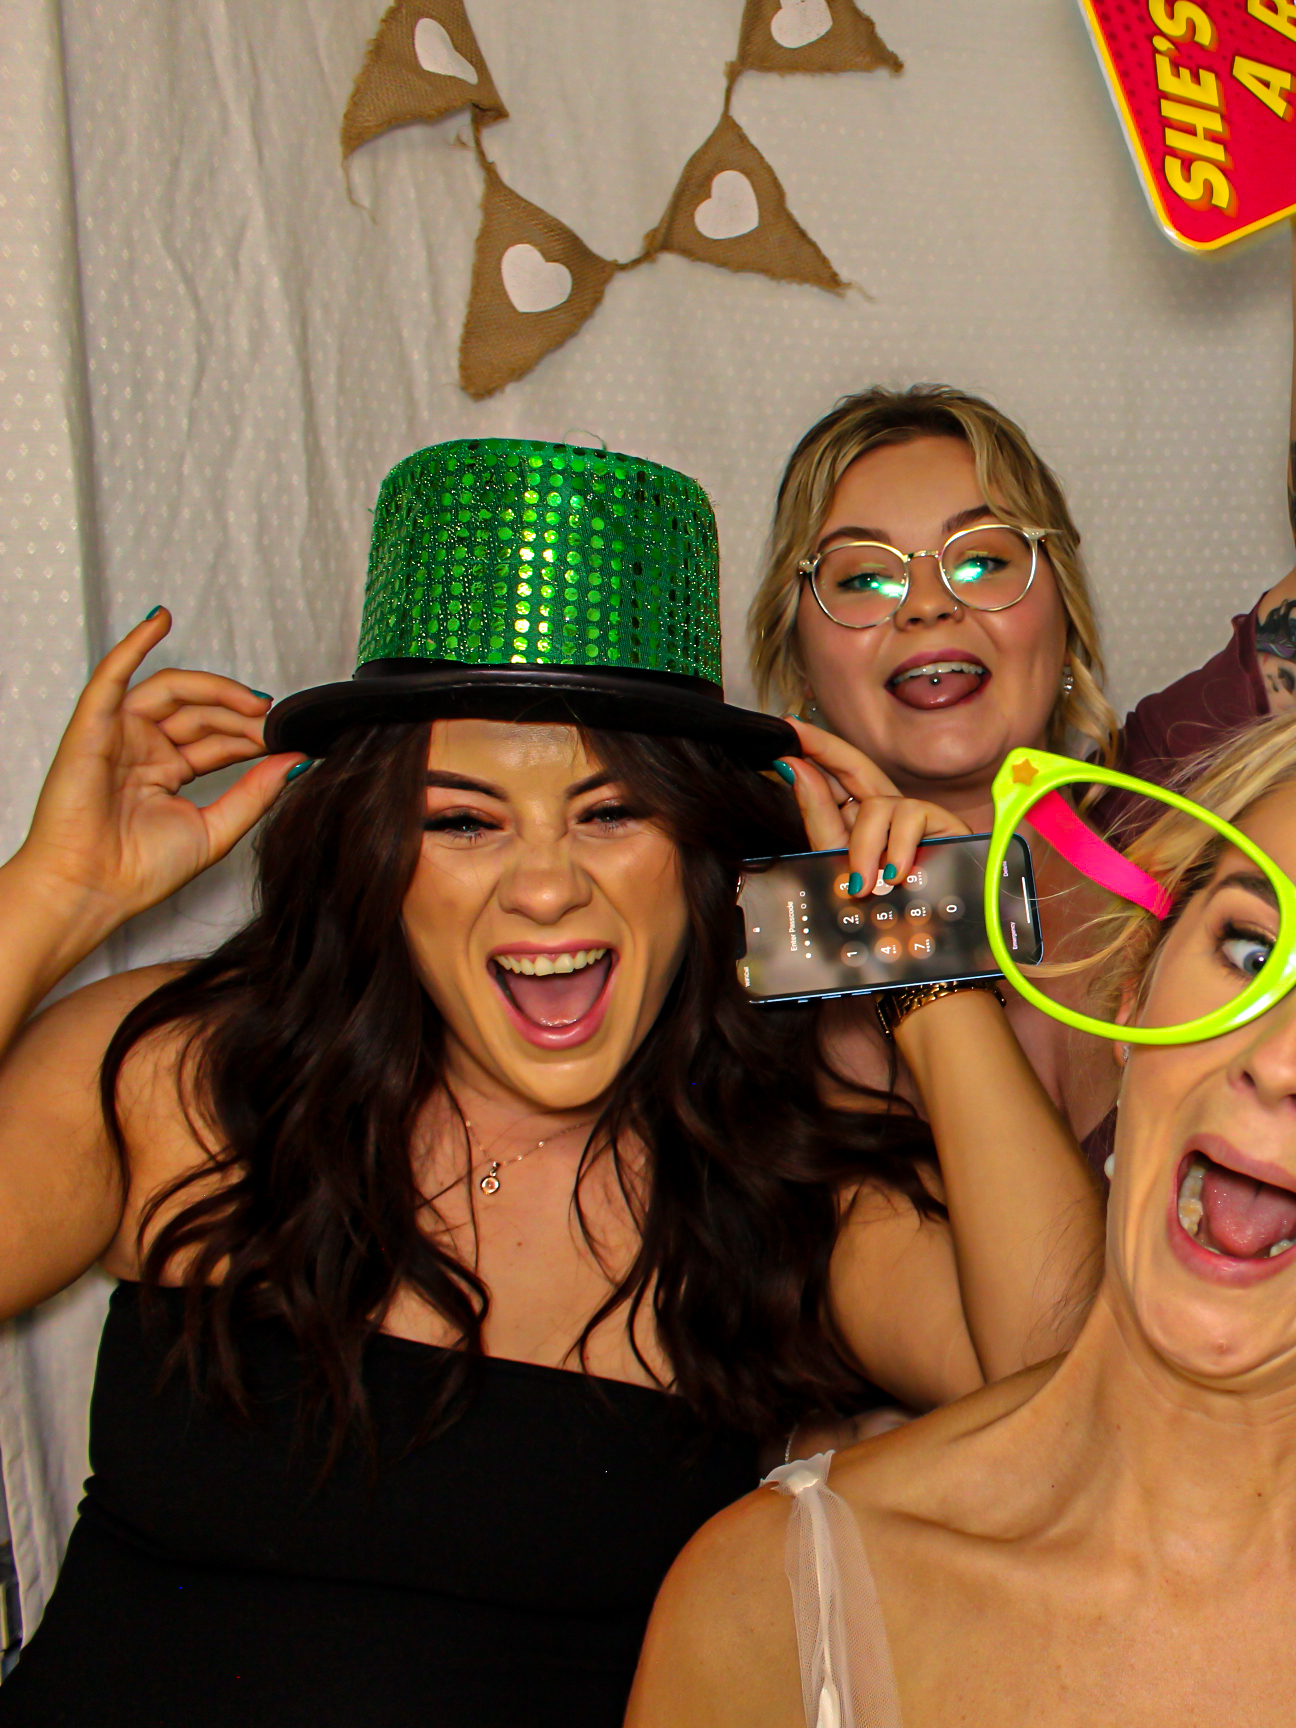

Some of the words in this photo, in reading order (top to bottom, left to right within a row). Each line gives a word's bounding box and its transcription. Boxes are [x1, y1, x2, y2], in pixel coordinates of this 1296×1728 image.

[1233, 55, 1292, 118] A
[1149, 0, 1231, 210] SHE'S
[906, 875, 918, 883] 9
[910, 908, 922, 917] 8
[946, 904, 957, 913] 0
[786, 901, 796, 933] Passcode
[843, 915, 854, 925] 2
[876, 912, 888, 920] 5
[790, 933, 798, 952] Enter
[914, 943, 925, 951] 7
[881, 946, 891, 954] 4
